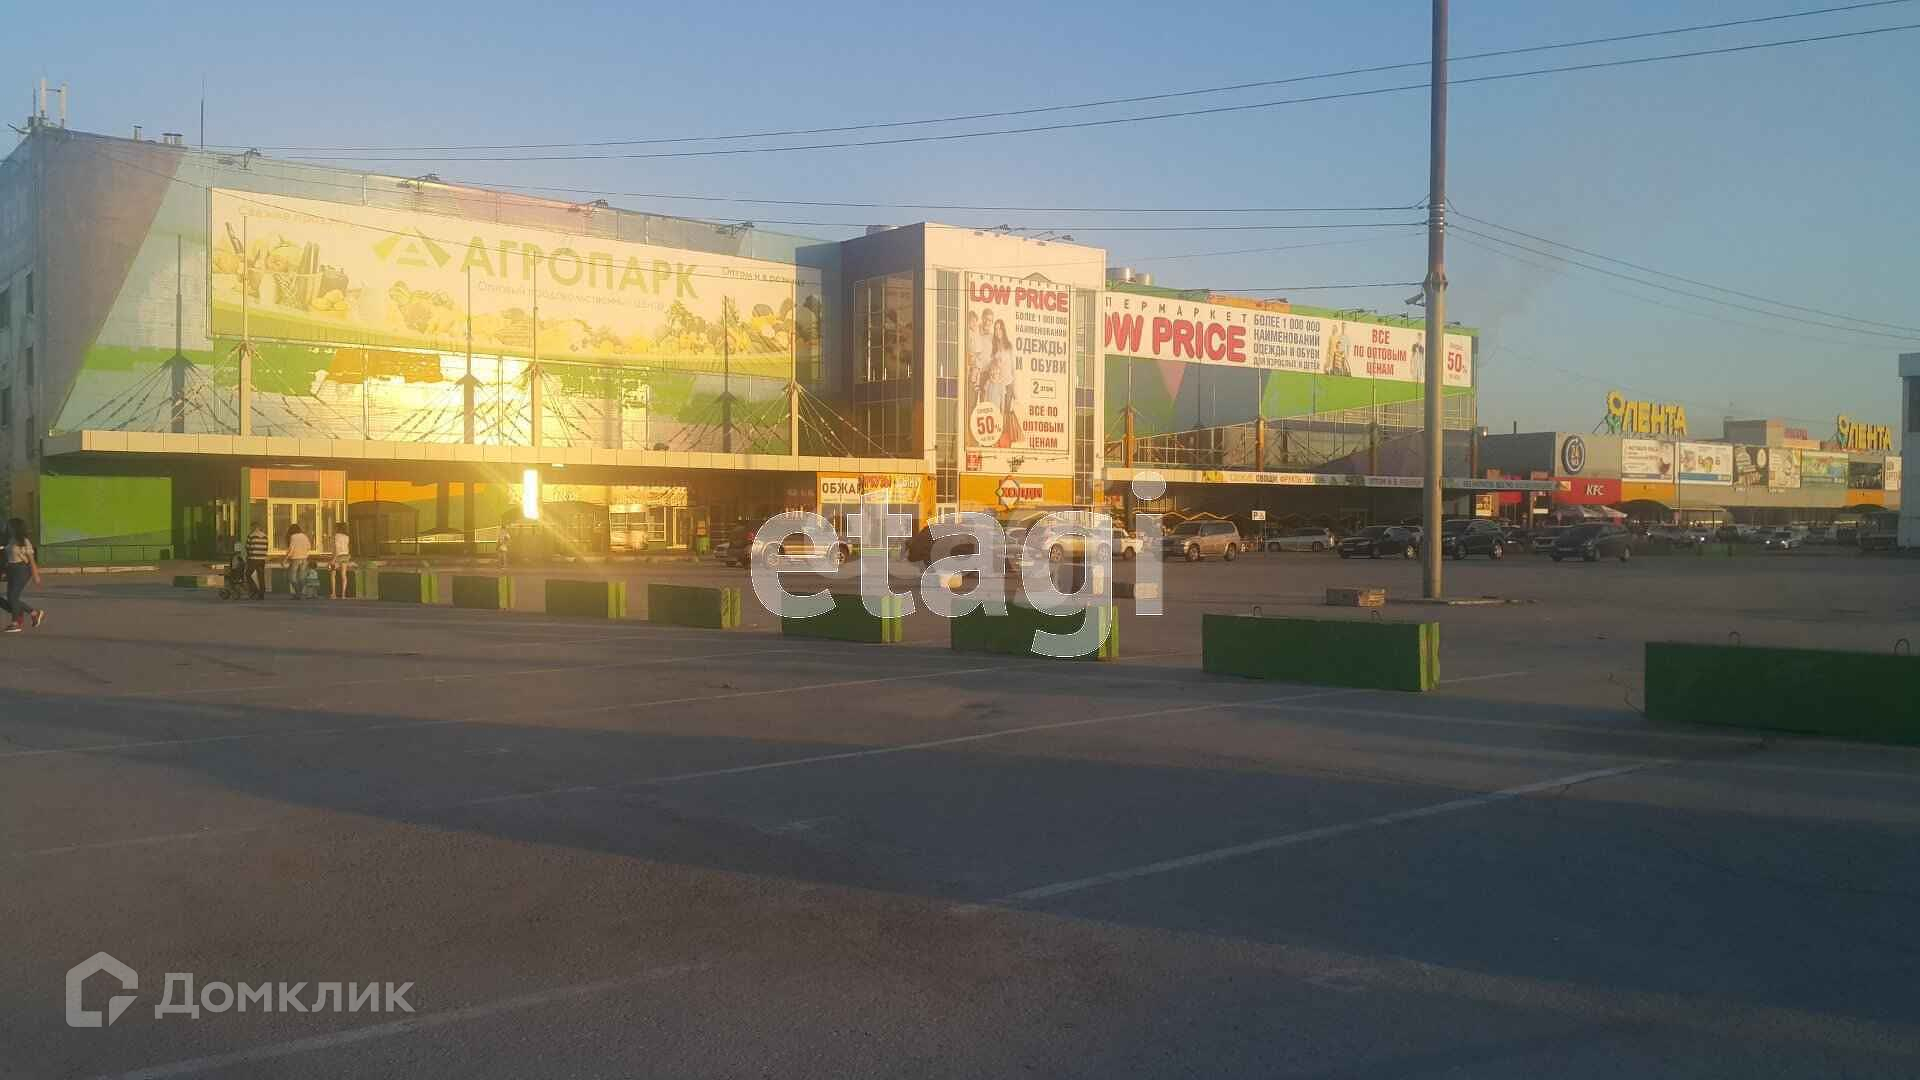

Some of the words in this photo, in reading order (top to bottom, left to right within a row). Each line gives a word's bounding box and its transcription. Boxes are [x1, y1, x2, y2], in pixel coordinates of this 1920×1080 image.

[460, 235, 699, 299] АГРОПАРК
[969, 280, 1012, 306] LOW
[1015, 286, 1069, 313] PRICE
[1253, 313, 1281, 328] БОЛЕЕ
[1283, 317, 1287, 329] 1
[1152, 316, 1247, 363] PRICE
[1371, 328, 1390, 345] ВСЕ
[1015, 337, 1067, 357] ОДЕЖДЫ
[1253, 342, 1288, 358] ОДЕЖДЫ
[1353, 344, 1364, 359] ПО
[1367, 346, 1407, 362] ОПТОВЫМ
[1015, 356, 1023, 371] И
[1030, 357, 1067, 374] ОБУВИ
[1366, 361, 1395, 376] ЦЕНАМ
[1032, 381, 1039, 395] 2
[1028, 405, 1045, 417] ВСЕ
[1047, 405, 1058, 417] ПО
[1622, 400, 1687, 436] ЛЕНТА
[1022, 420, 1065, 433] ОПТОВЫМ
[1029, 437, 1058, 449] ЦЕНАМ
[1848, 422, 1892, 451] ЛЕНТА
[1586, 482, 1605, 496] KFC
